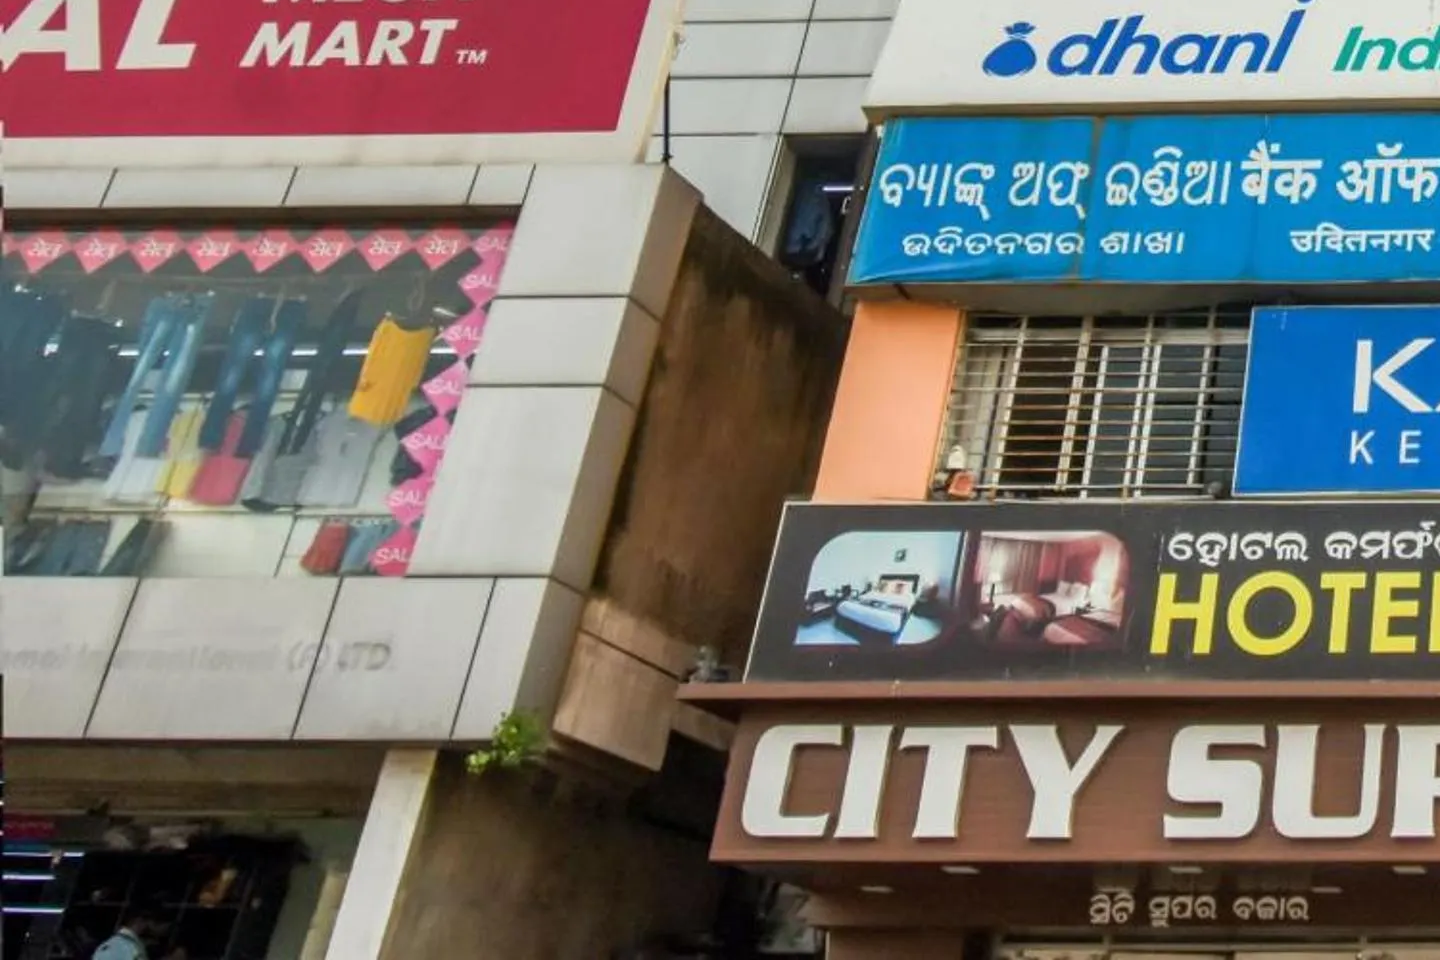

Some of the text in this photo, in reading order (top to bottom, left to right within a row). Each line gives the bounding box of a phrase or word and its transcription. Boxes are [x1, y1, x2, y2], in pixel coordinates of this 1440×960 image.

[240, 19, 457, 67] MART
[1241, 140, 1322, 204] बैंक
[1290, 222, 1435, 253] उदितनगर
[742, 725, 1123, 838] CITY
